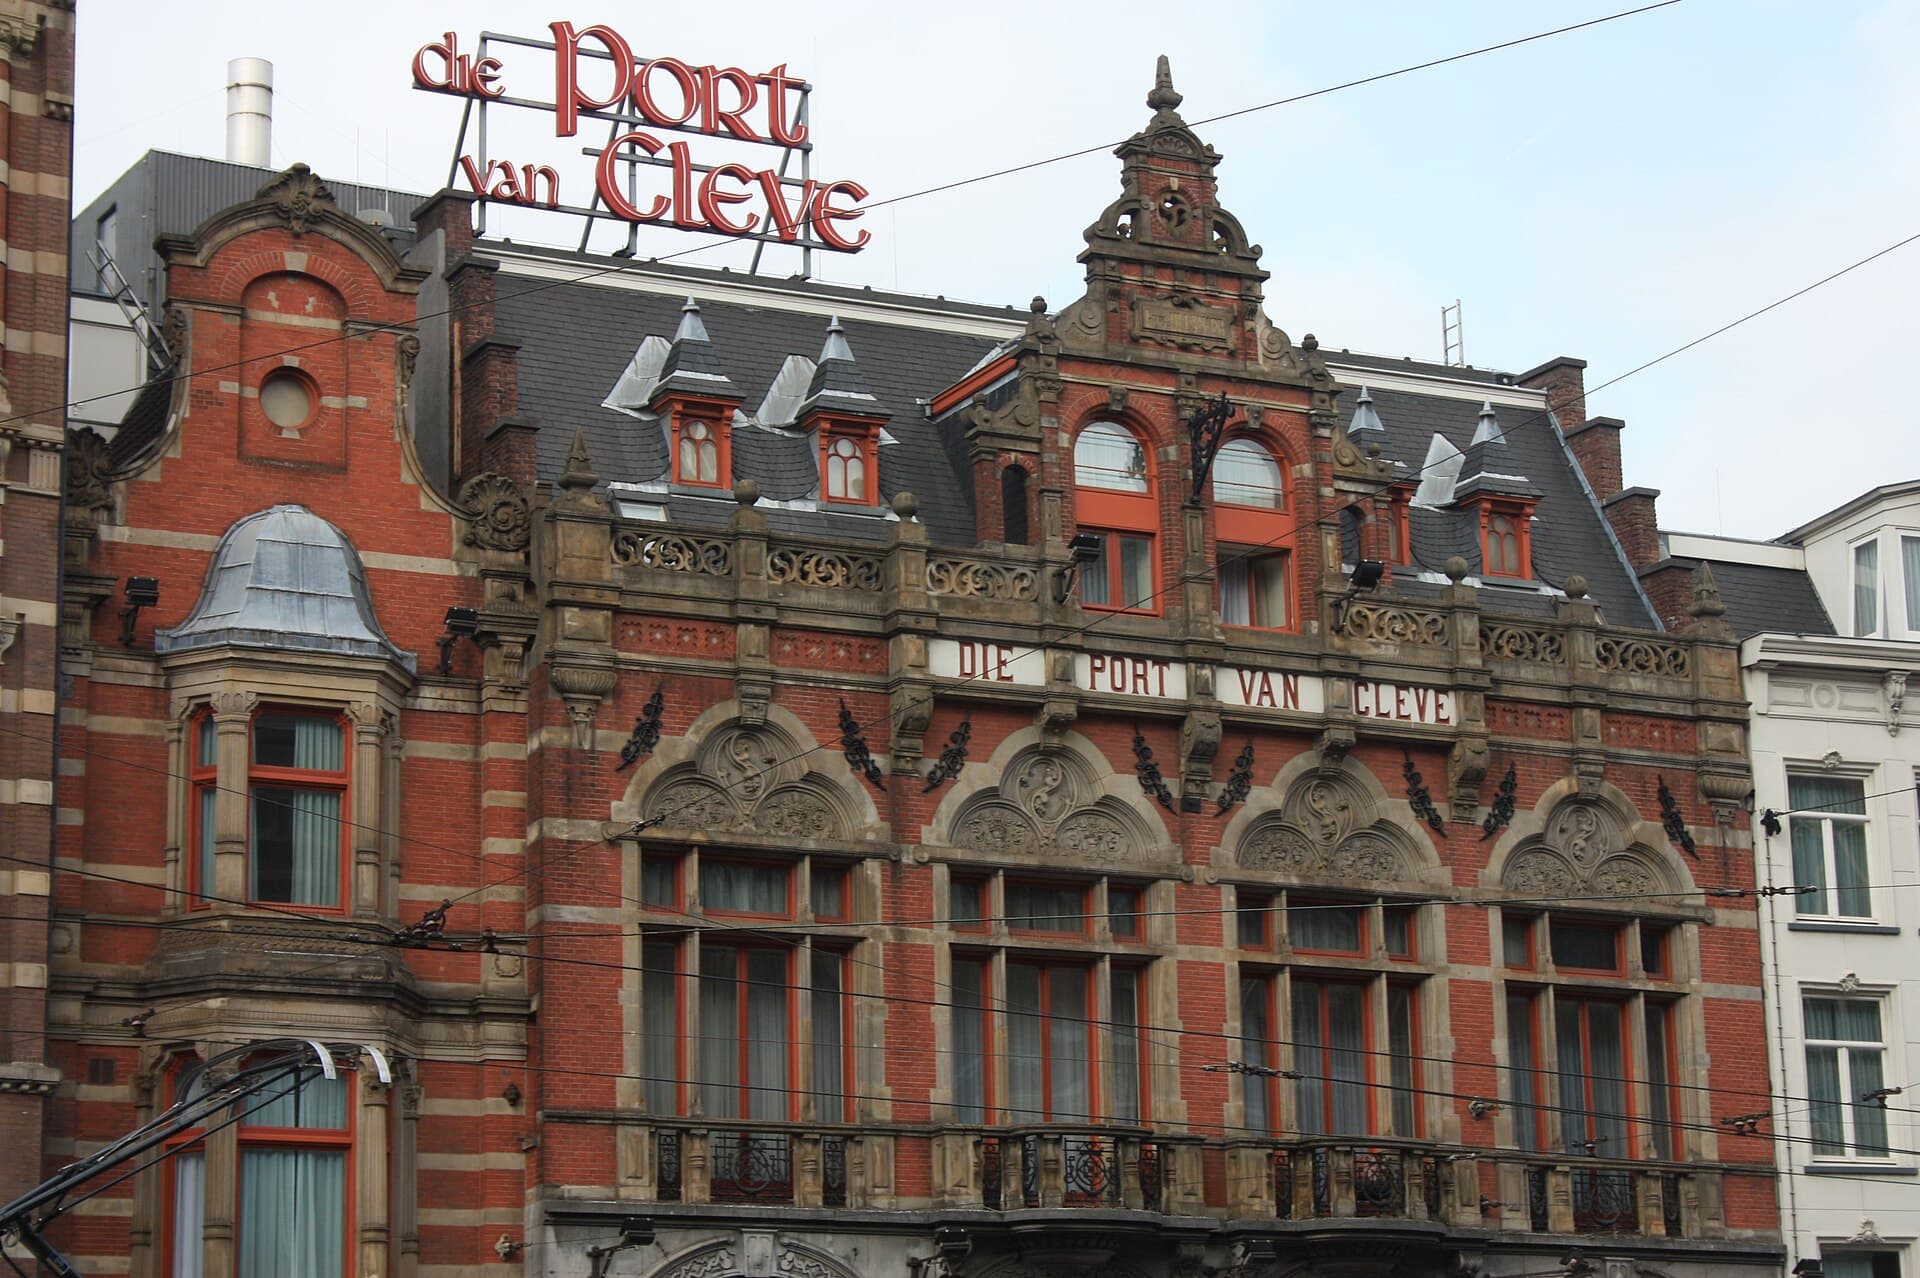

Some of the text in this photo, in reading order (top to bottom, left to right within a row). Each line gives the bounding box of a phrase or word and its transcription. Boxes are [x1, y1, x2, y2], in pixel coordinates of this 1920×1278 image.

[460, 155, 560, 207] van
[959, 641, 1450, 724] DIE PORT VAN CLEVE
